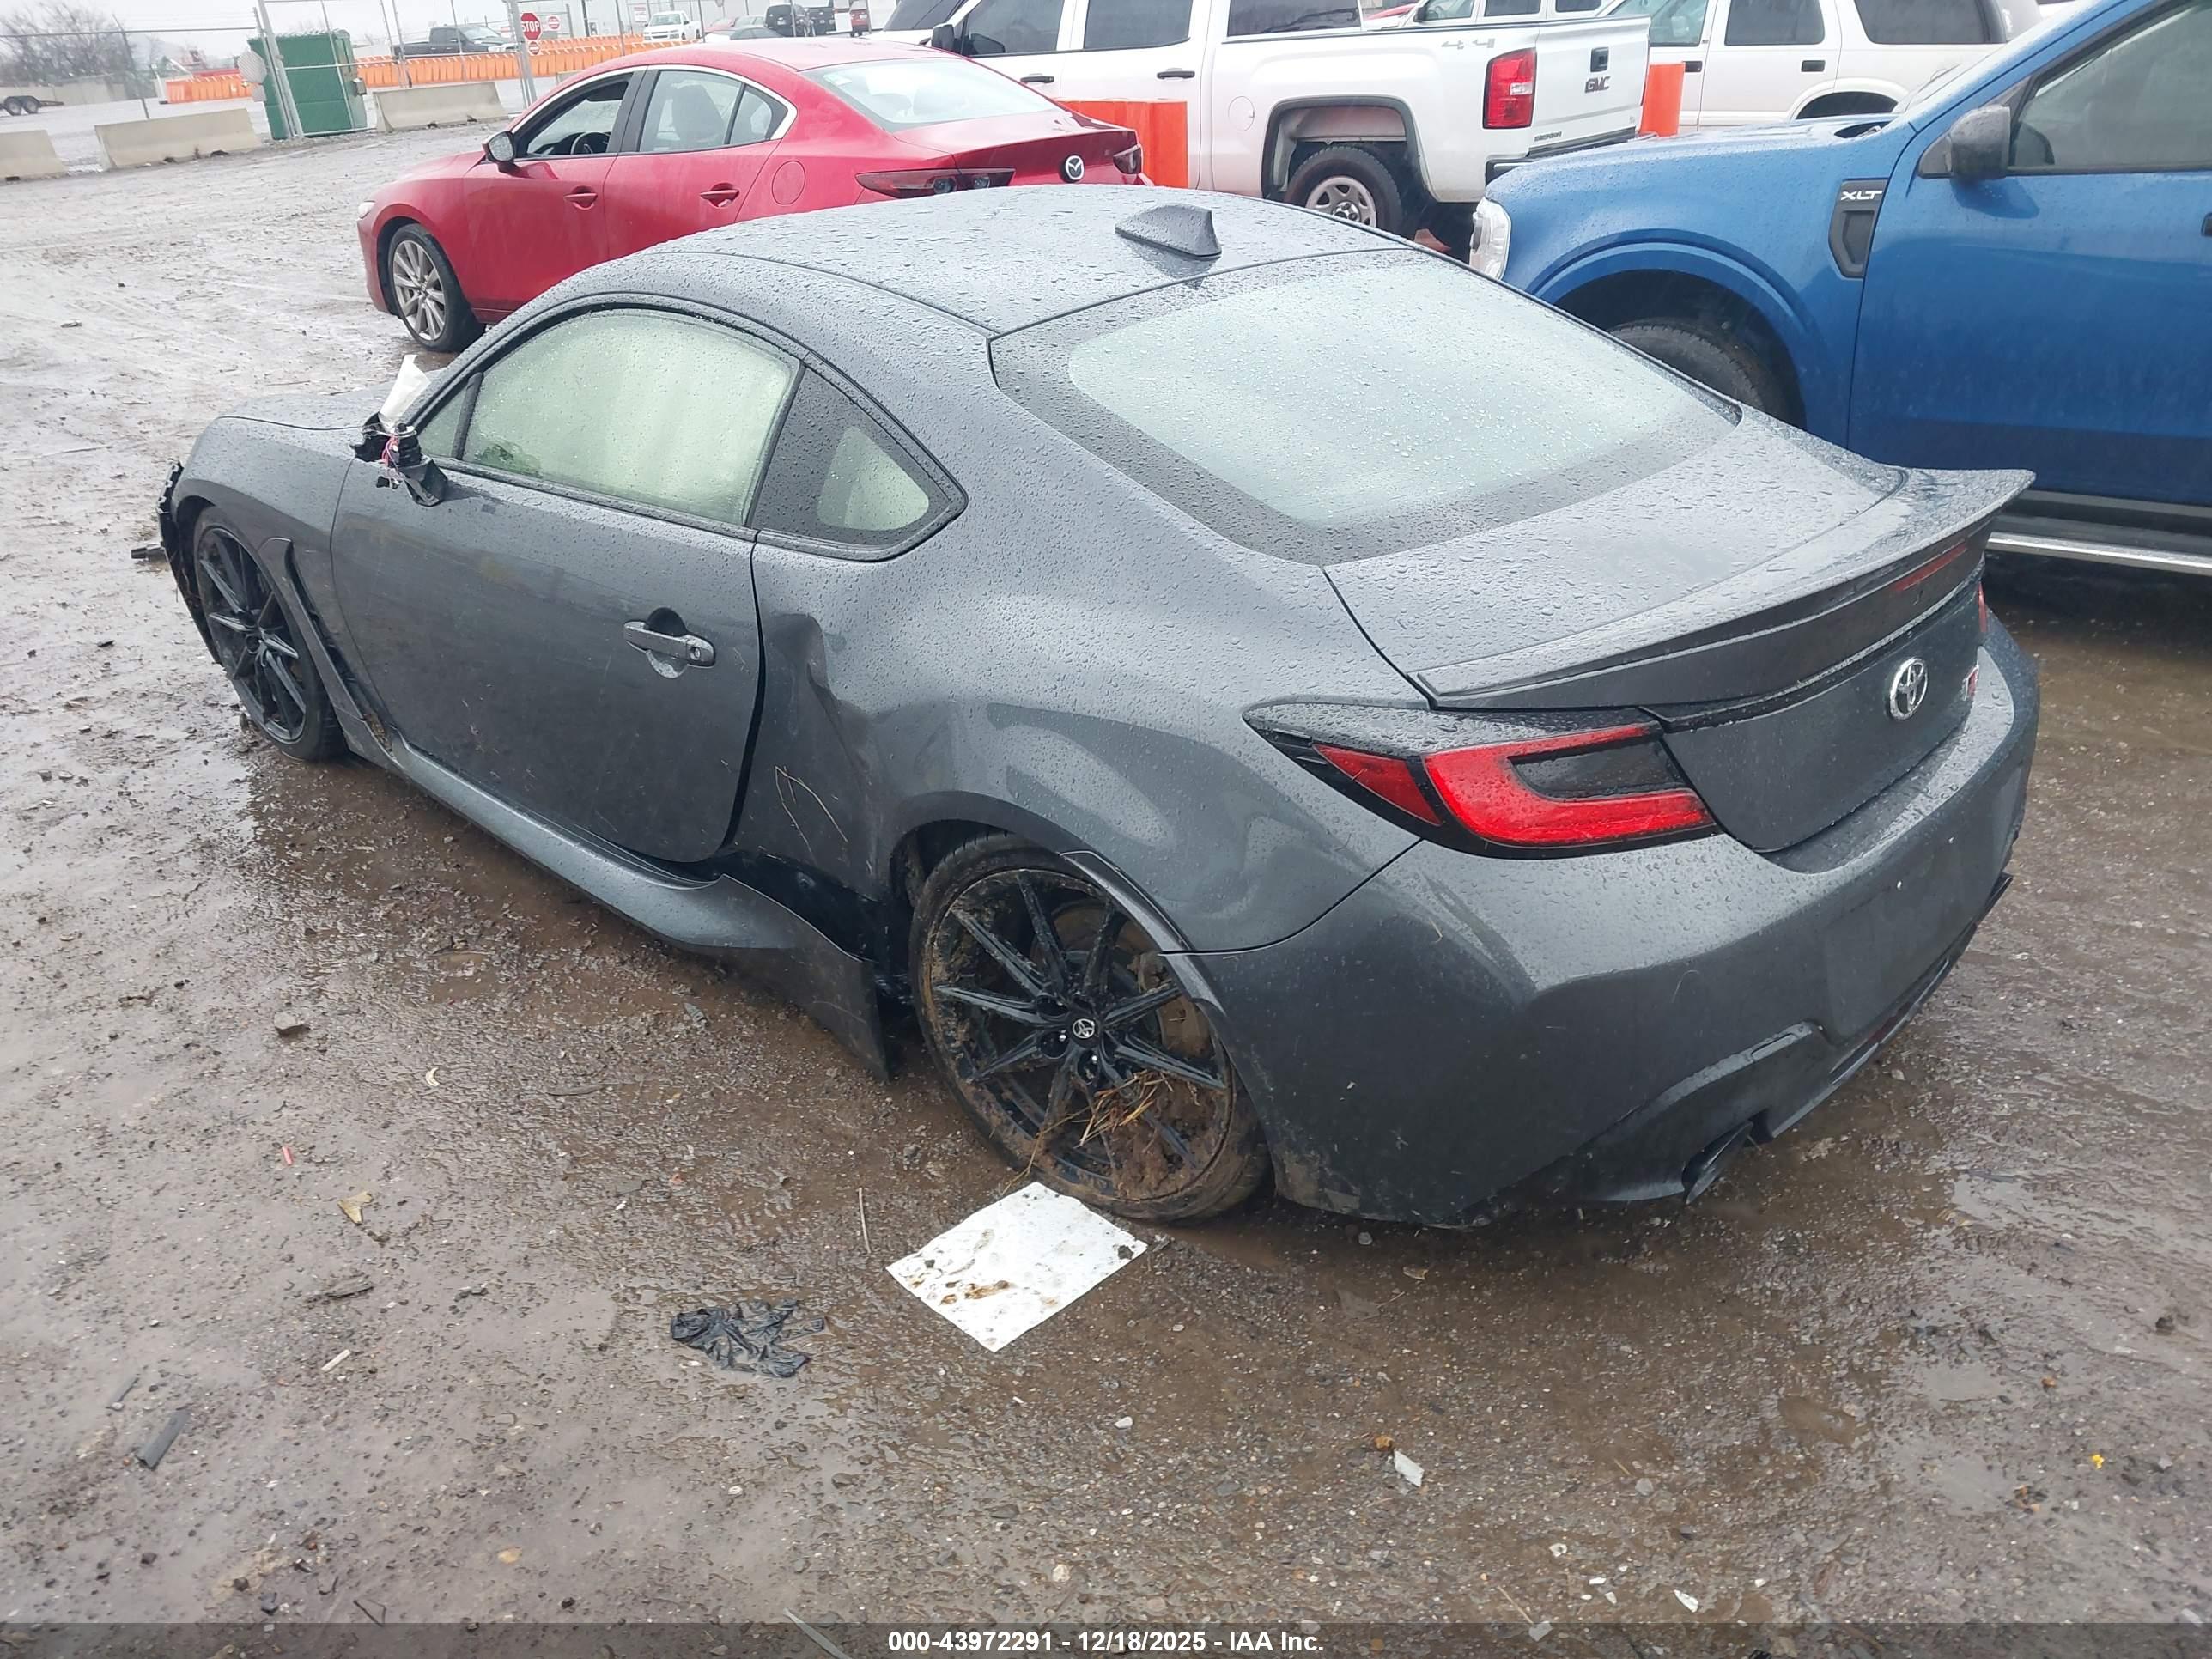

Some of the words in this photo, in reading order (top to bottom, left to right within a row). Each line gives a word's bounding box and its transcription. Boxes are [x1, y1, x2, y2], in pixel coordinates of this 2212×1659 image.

[521, 21, 540, 33] STOP
[1441, 38, 1496, 50] 44
[1584, 76, 1611, 94] GMC
[1840, 190, 1883, 201] XLT
